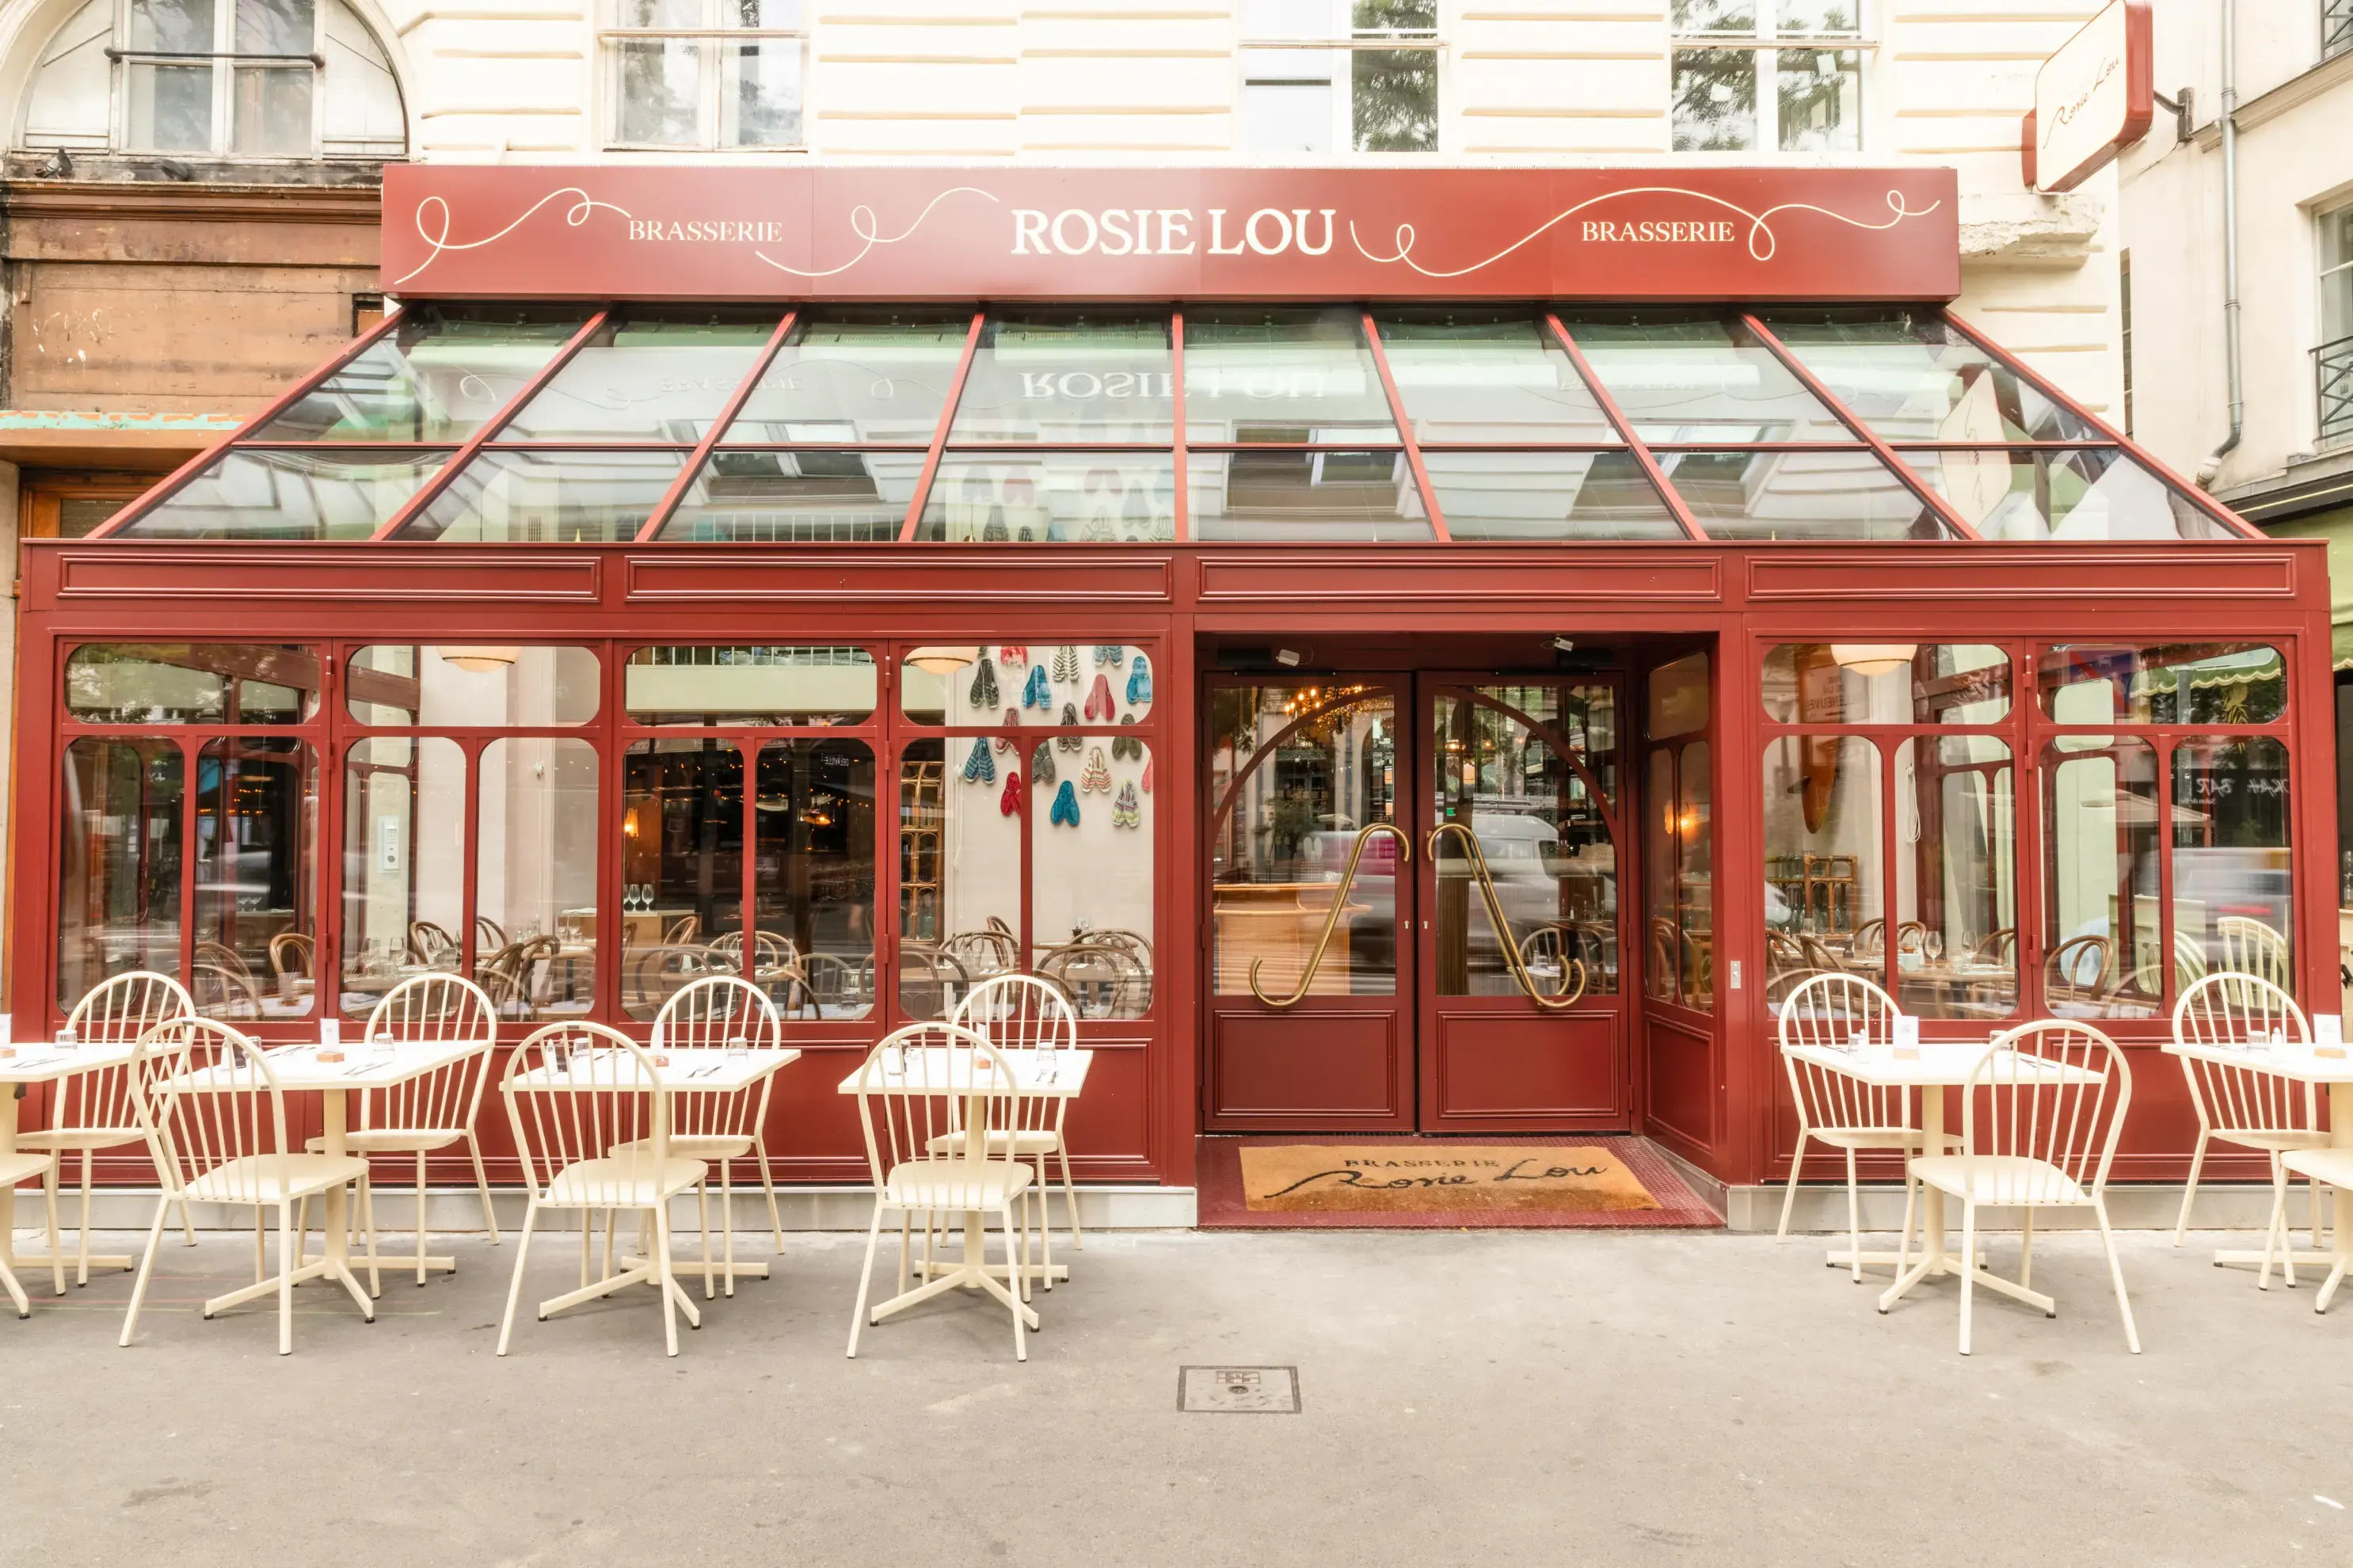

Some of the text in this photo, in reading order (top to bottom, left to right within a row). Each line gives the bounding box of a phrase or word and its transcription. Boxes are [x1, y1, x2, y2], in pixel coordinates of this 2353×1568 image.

[2092, 56, 2119, 93] Lou
[628, 220, 783, 242] BRASSERIE
[1010, 208, 1337, 256] ROSIE LOU
[1581, 221, 1736, 243] BRASSERIE
[1343, 1159, 1501, 1169] BRASSERIE
[1263, 1158, 1609, 1200] Rosie Lou
